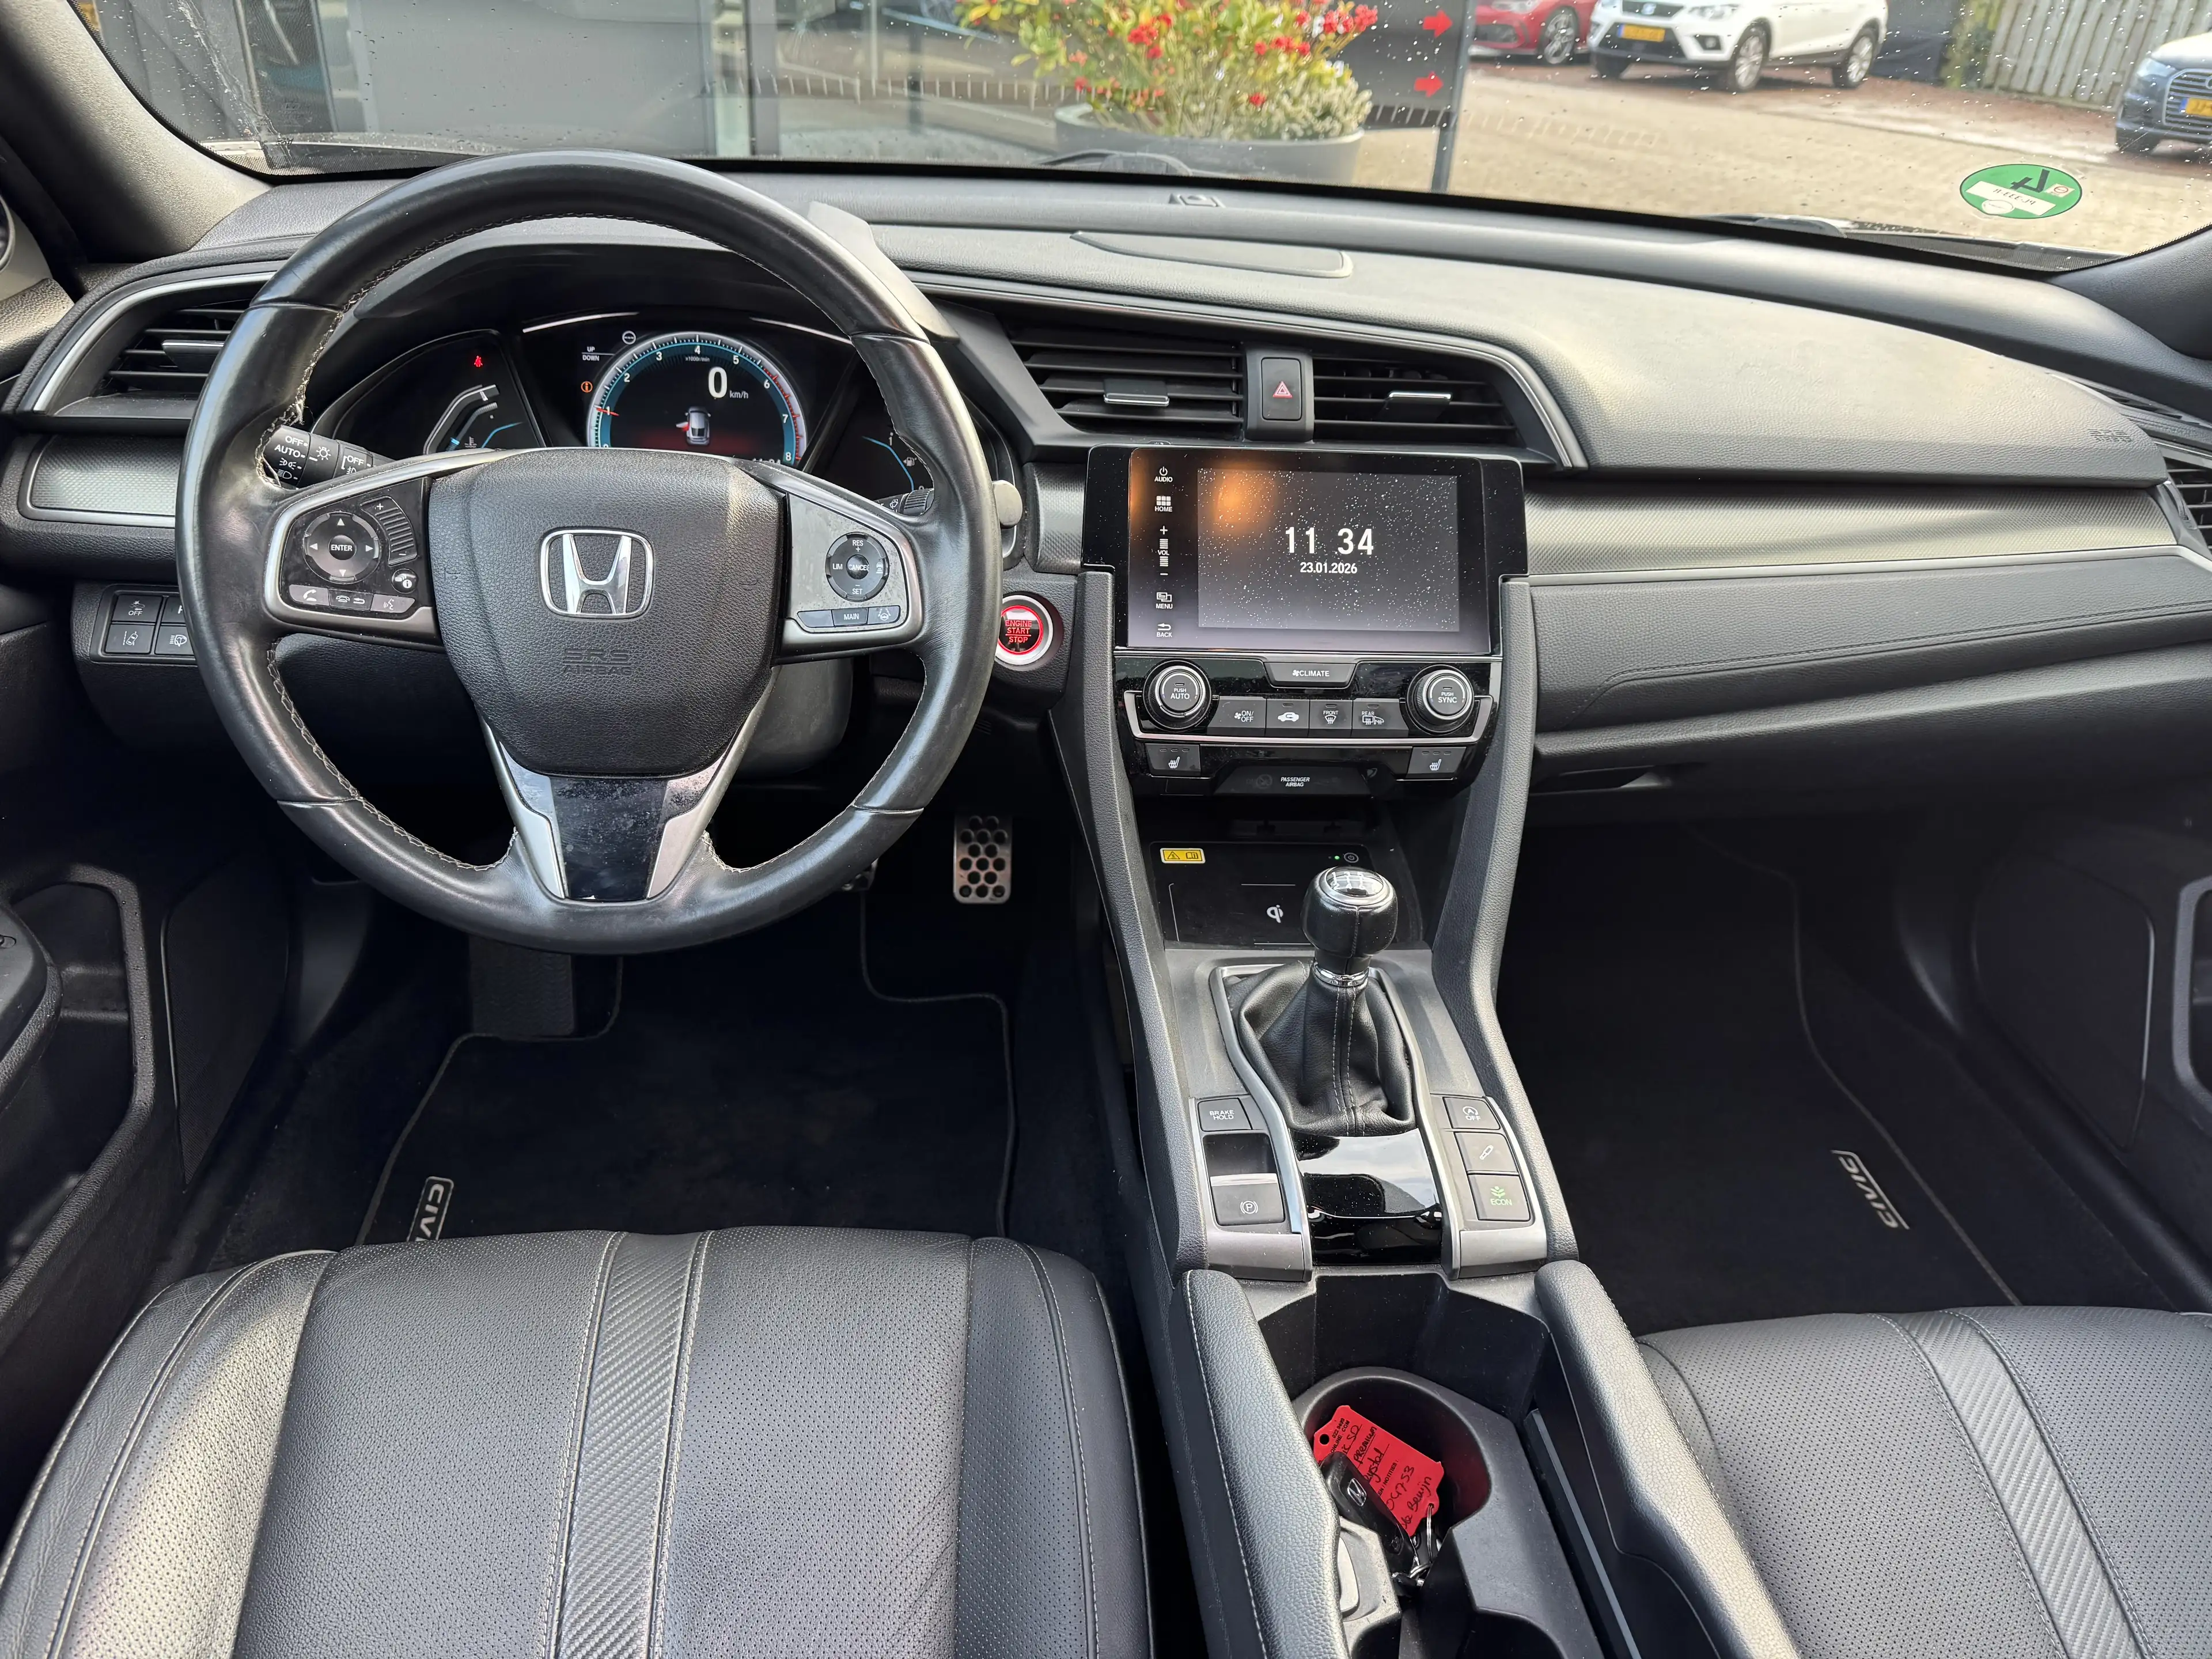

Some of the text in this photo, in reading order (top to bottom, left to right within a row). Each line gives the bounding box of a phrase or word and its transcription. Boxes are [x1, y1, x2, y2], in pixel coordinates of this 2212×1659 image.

[656, 351, 662, 361] 3
[694, 346, 701, 355] 4
[733, 355, 740, 365] 5
[624, 372, 630, 382] 2
[708, 366, 749, 399] 0 km/h
[763, 378, 771, 389] 6
[782, 414, 789, 423] 7
[285, 435, 304, 446] OFF
[275, 444, 301, 458] AUTO
[785, 452, 792, 461] 8
[347, 455, 364, 466] OFF
[1285, 527, 1374, 555] 11 34
[1300, 562, 1358, 574] 23.01.2026
[564, 649, 630, 664] SRS
[564, 666, 633, 676] AIRBAG
[1838, 1156, 1899, 1228] CIVIC
[415, 1184, 444, 1241] CIV
